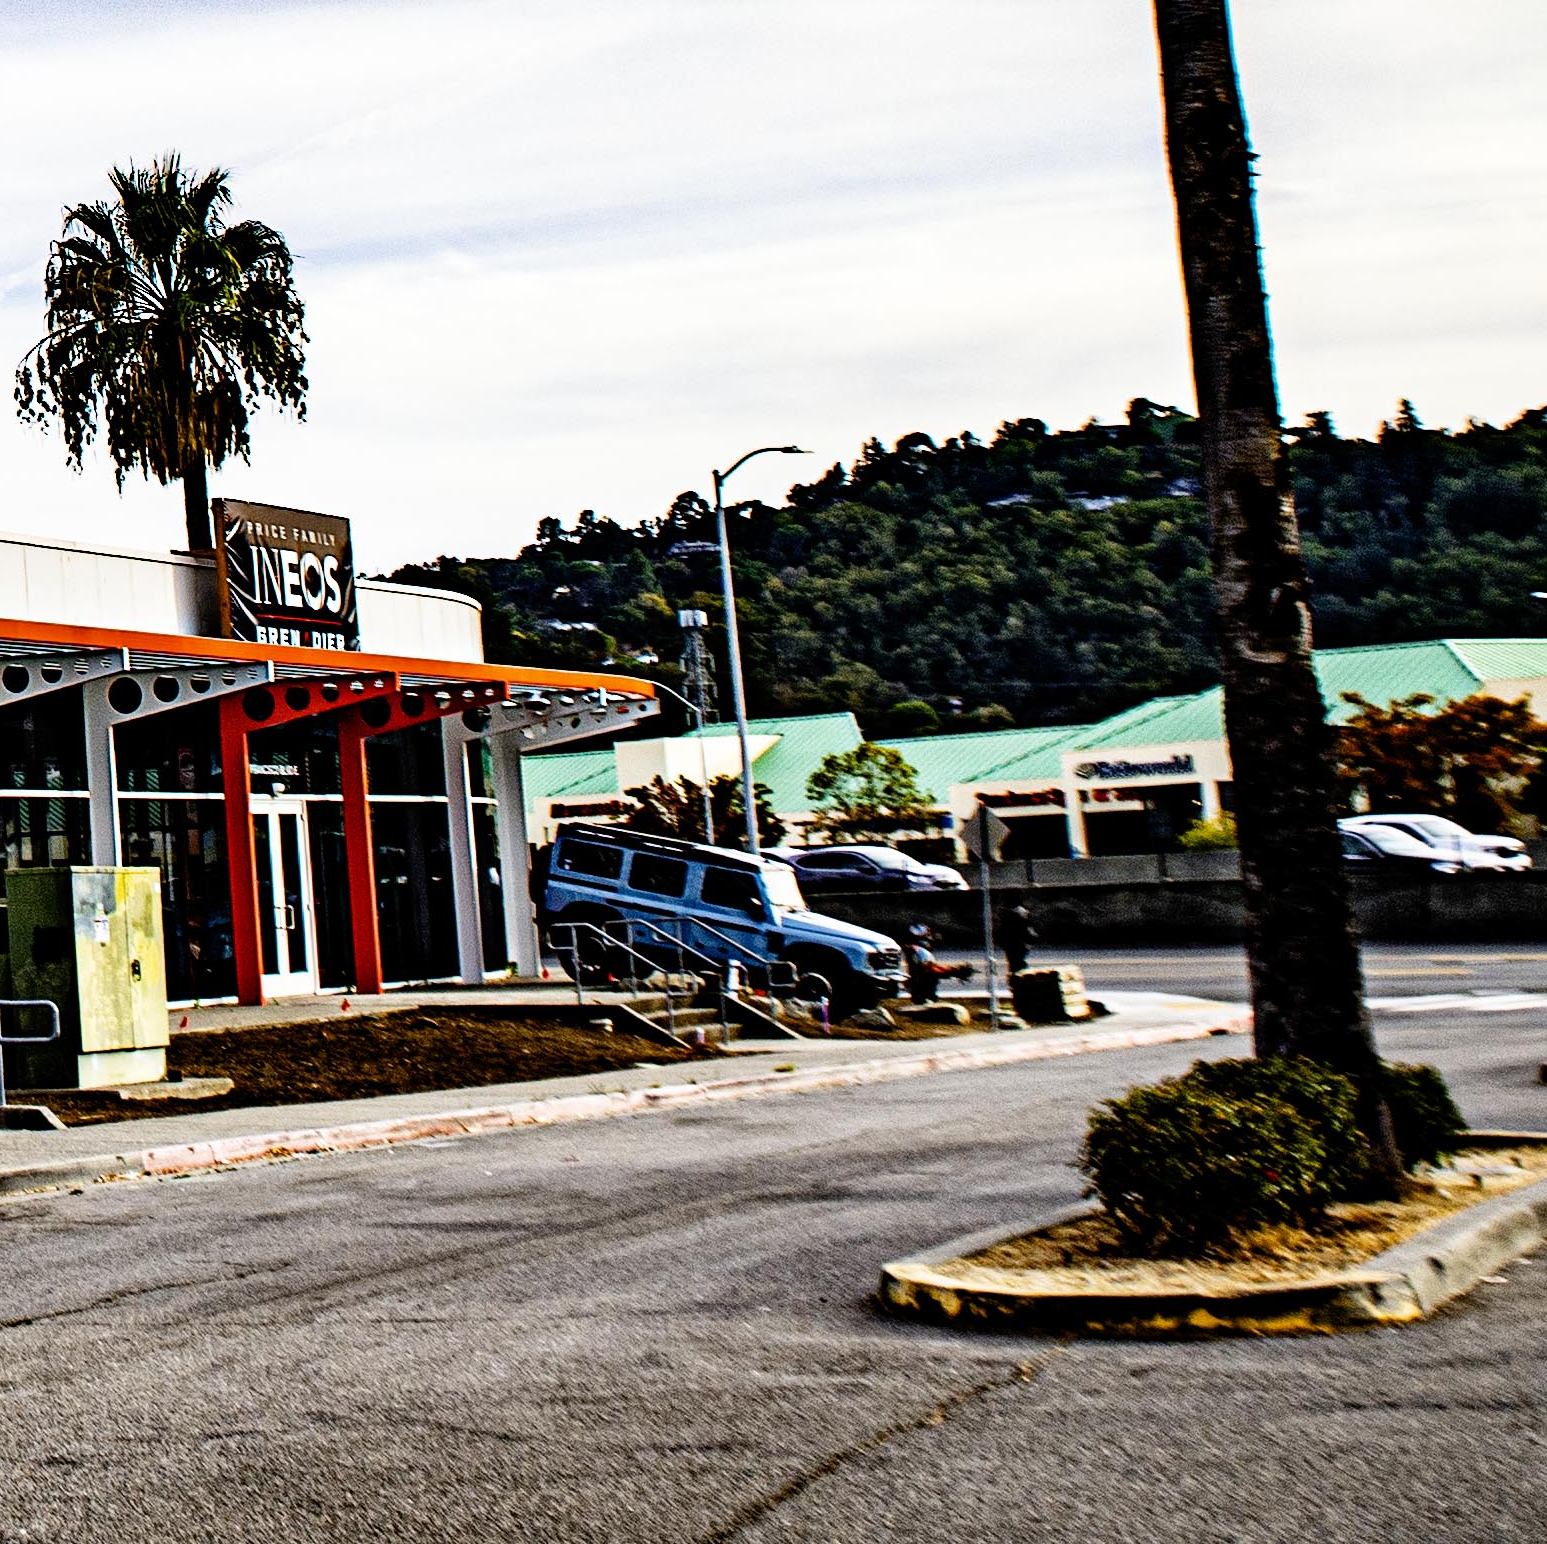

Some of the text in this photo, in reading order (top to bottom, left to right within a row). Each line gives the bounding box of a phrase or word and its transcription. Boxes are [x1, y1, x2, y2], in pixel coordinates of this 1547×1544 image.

[247, 520, 336, 547] PRICE FAMILY
[249, 544, 342, 614] INEOS
